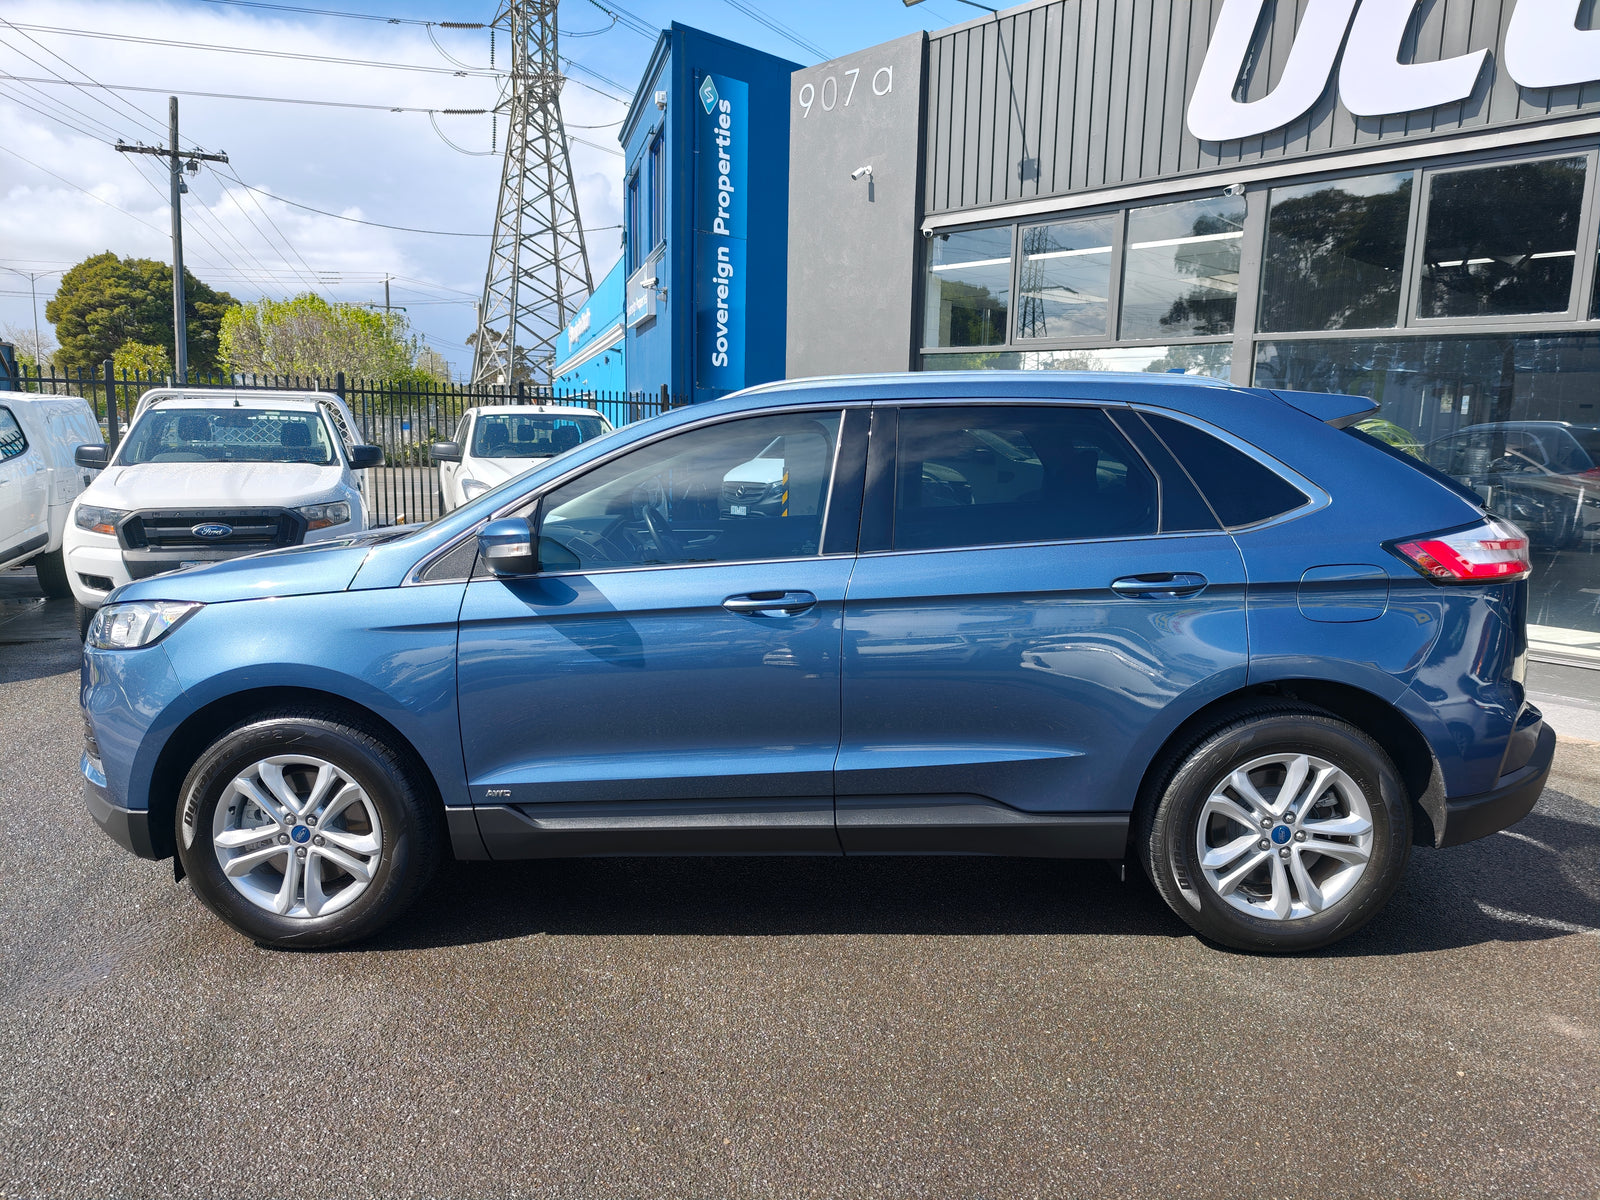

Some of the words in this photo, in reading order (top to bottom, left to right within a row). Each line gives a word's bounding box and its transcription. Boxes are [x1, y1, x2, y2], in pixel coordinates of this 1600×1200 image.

[713, 98, 734, 236] Properties
[712, 246, 733, 367] Sovereign
[201, 528, 224, 537] Ford
[486, 789, 512, 797] AWD
